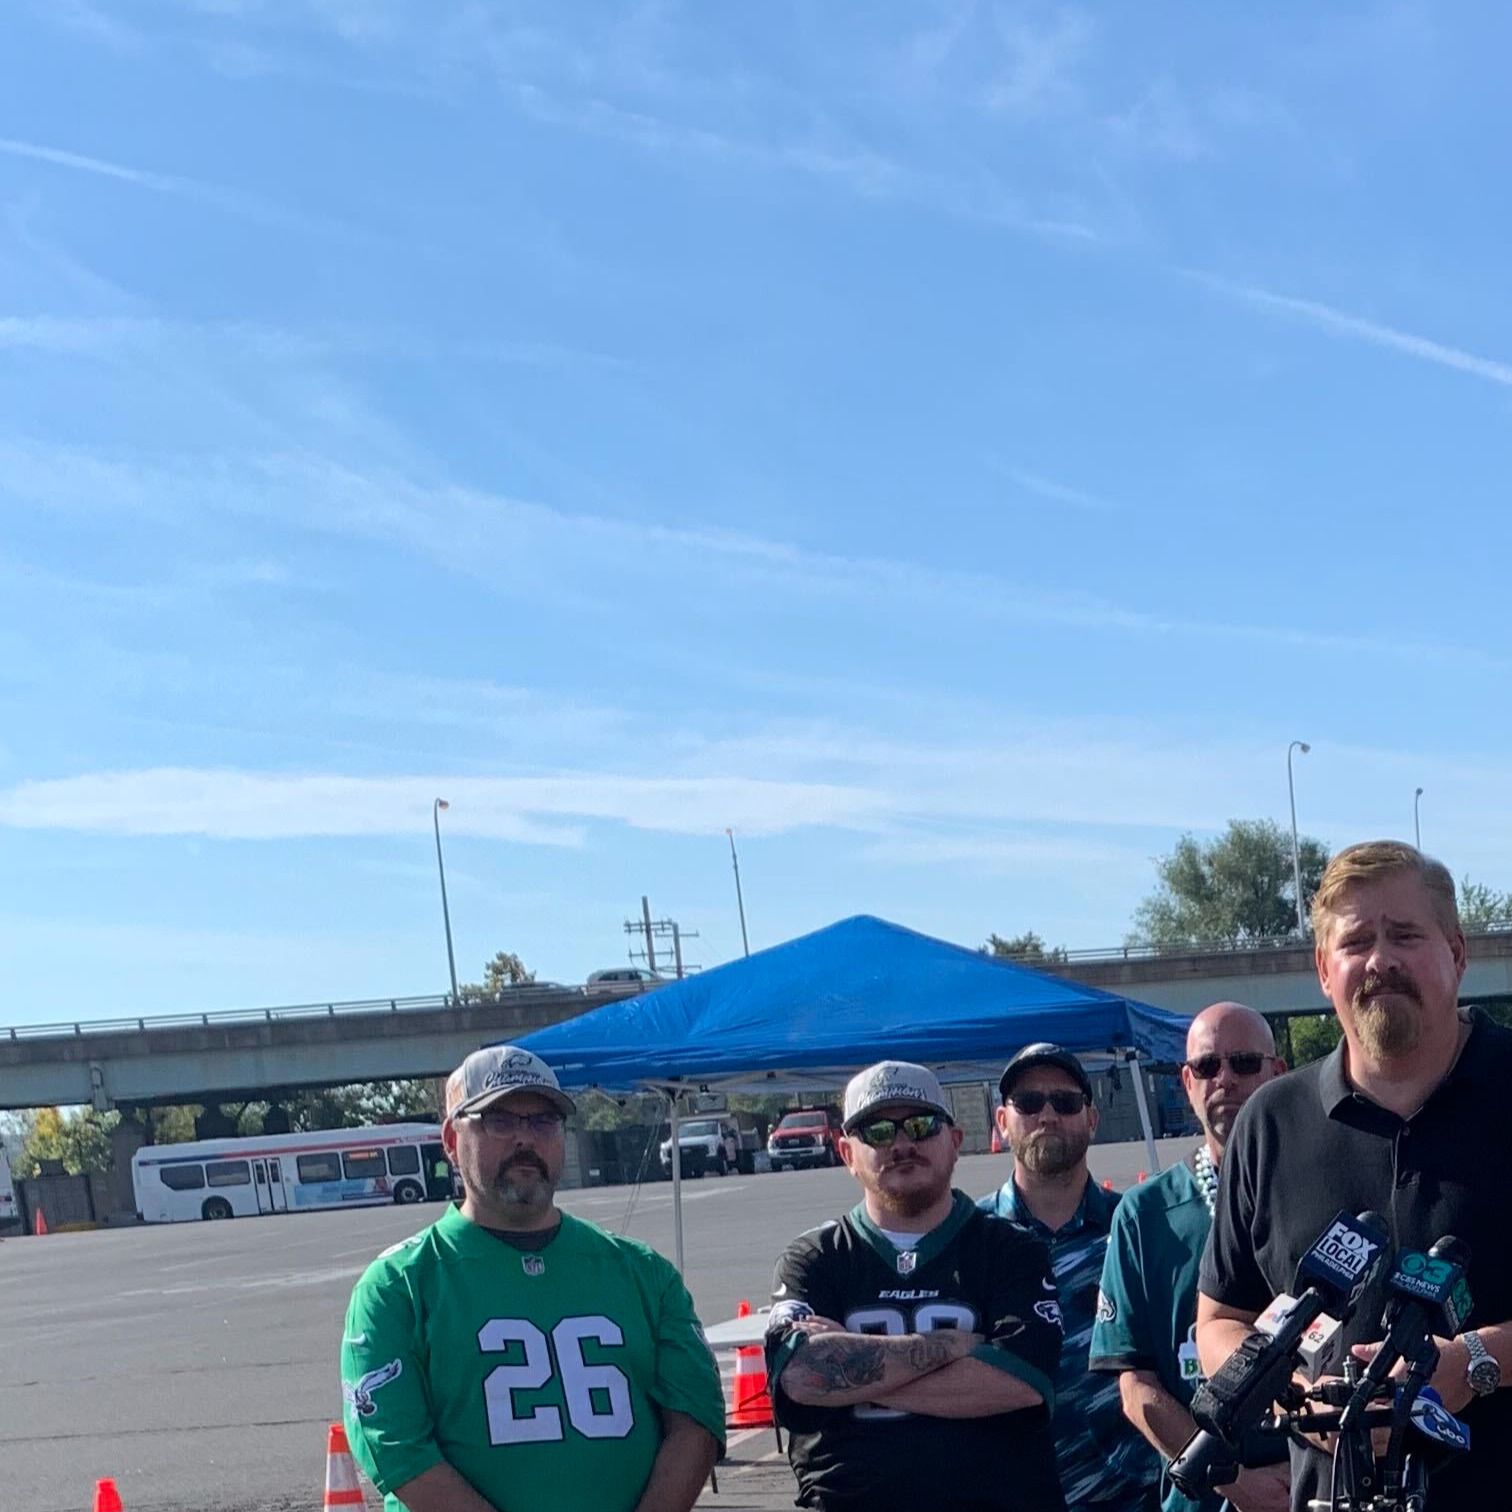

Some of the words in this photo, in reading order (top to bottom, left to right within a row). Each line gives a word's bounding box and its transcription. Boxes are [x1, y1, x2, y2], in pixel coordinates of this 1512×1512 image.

[1318, 1237, 1364, 1273] LOCAL
[1327, 1221, 1379, 1260] FOX
[1311, 1250, 1355, 1280] PHILADELPHIA
[878, 1289, 939, 1299] EAGLES
[1416, 1279, 1441, 1293] NEWS
[1308, 1331, 1324, 1343] 62
[478, 1314, 634, 1446] 26
